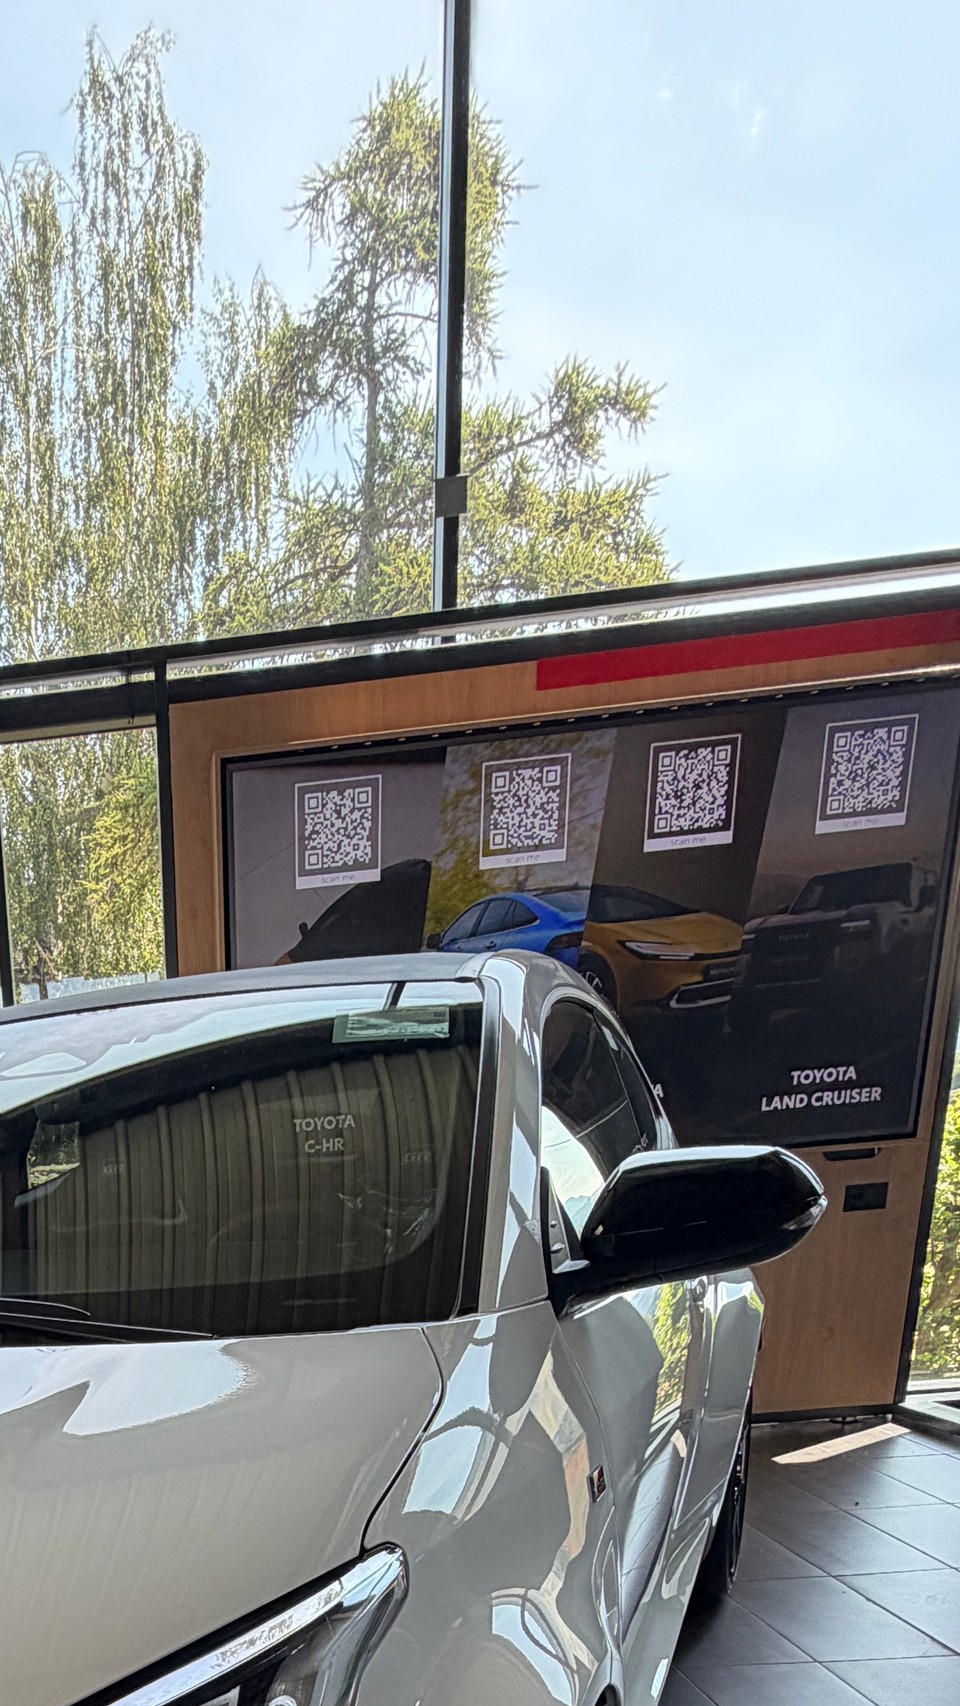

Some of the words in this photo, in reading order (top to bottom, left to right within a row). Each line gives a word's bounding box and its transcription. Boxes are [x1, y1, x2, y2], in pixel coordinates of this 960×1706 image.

[842, 819, 863, 829] scan
[865, 817, 879, 826] me
[670, 837, 690, 846] scan
[505, 856, 524, 864] scan
[526, 853, 540, 861] me
[321, 875, 339, 883] scan
[341, 873, 355, 881] me
[777, 932, 809, 941] TOYOTA
[790, 1065, 857, 1086] TOYOTA
[761, 1094, 808, 1112] LAND
[810, 1086, 882, 1107] CRUISER
[293, 1114, 356, 1133] TOYOTA
[304, 1137, 344, 1154] C-HR
[403, 1151, 433, 1163] GR
